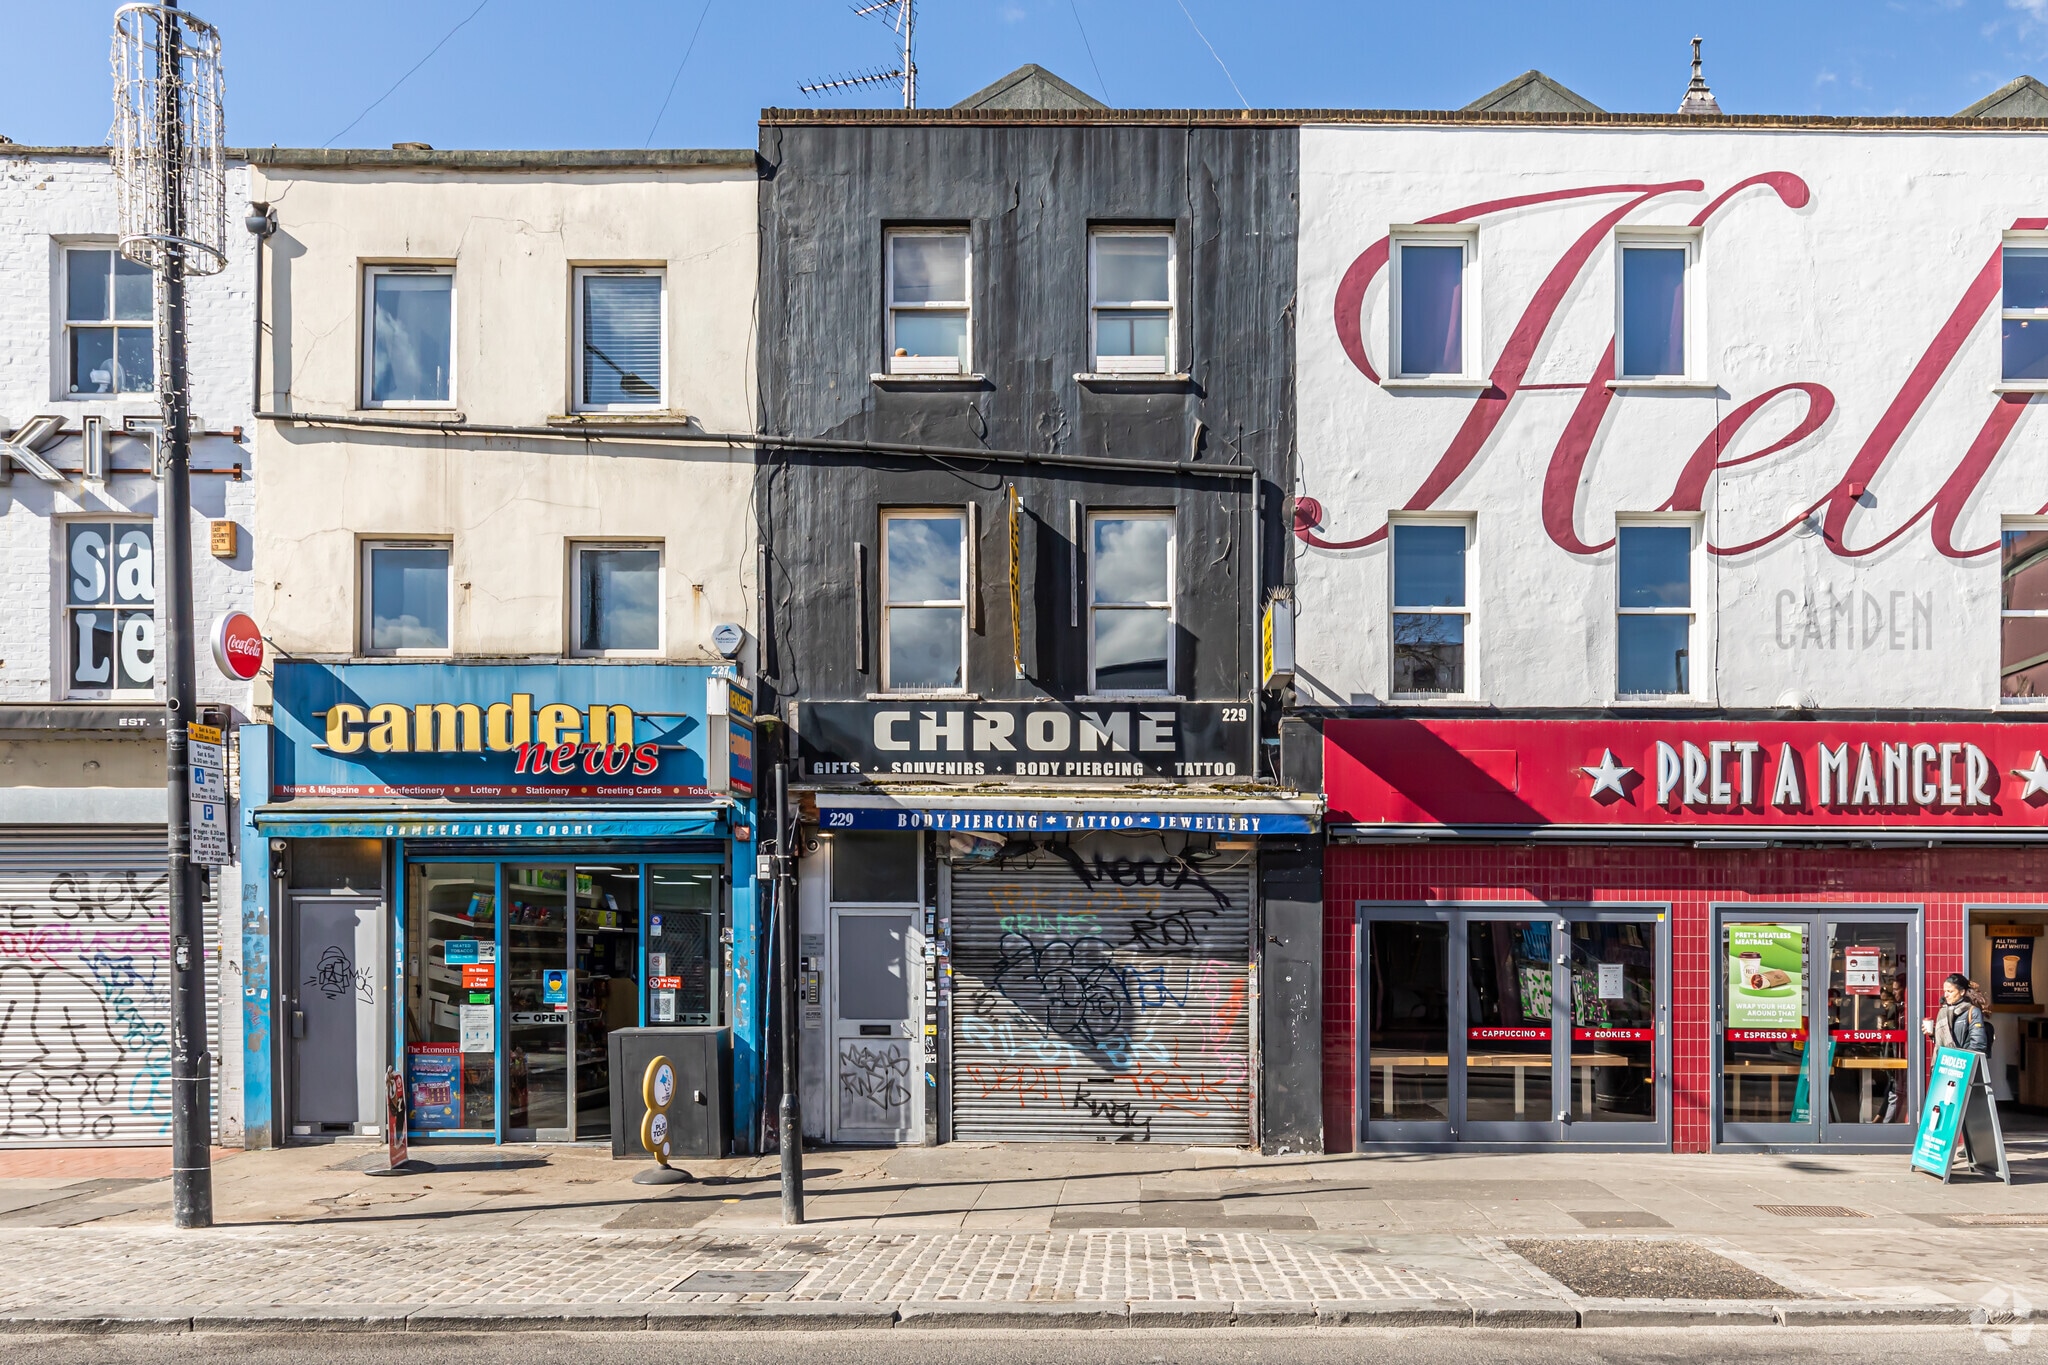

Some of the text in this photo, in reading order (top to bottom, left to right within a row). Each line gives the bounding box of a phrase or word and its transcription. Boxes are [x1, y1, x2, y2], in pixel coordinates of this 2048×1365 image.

[1775, 589, 1933, 650] CAMDEN
[1222, 708, 1247, 721] 229
[119, 718, 150, 726] EST.
[326, 693, 634, 753] camden
[874, 711, 1176, 751] CHROME
[514, 741, 659, 775] news
[813, 762, 861, 773] GIFTS
[1016, 762, 1060, 775] BODY
[1065, 762, 1144, 775] PIERCING
[1175, 762, 1236, 775] TATTOO
[1656, 740, 1991, 806] PRET A MANGER
[283, 785, 359, 796] News & Magazine
[384, 786, 445, 796] Confectionery
[470, 786, 501, 796] Lottery
[526, 786, 570, 796] Stationery
[597, 786, 662, 796] Greeting Cards
[829, 813, 1260, 831] 229 BODY PIERCING TATTOO JEWELLERY
[474, 824, 522, 835] NEWS
[533, 1014, 564, 1022] OPEN
[1854, 1032, 1882, 1040] SOUPS
[1941, 1054, 1967, 1070] ENDLESS
